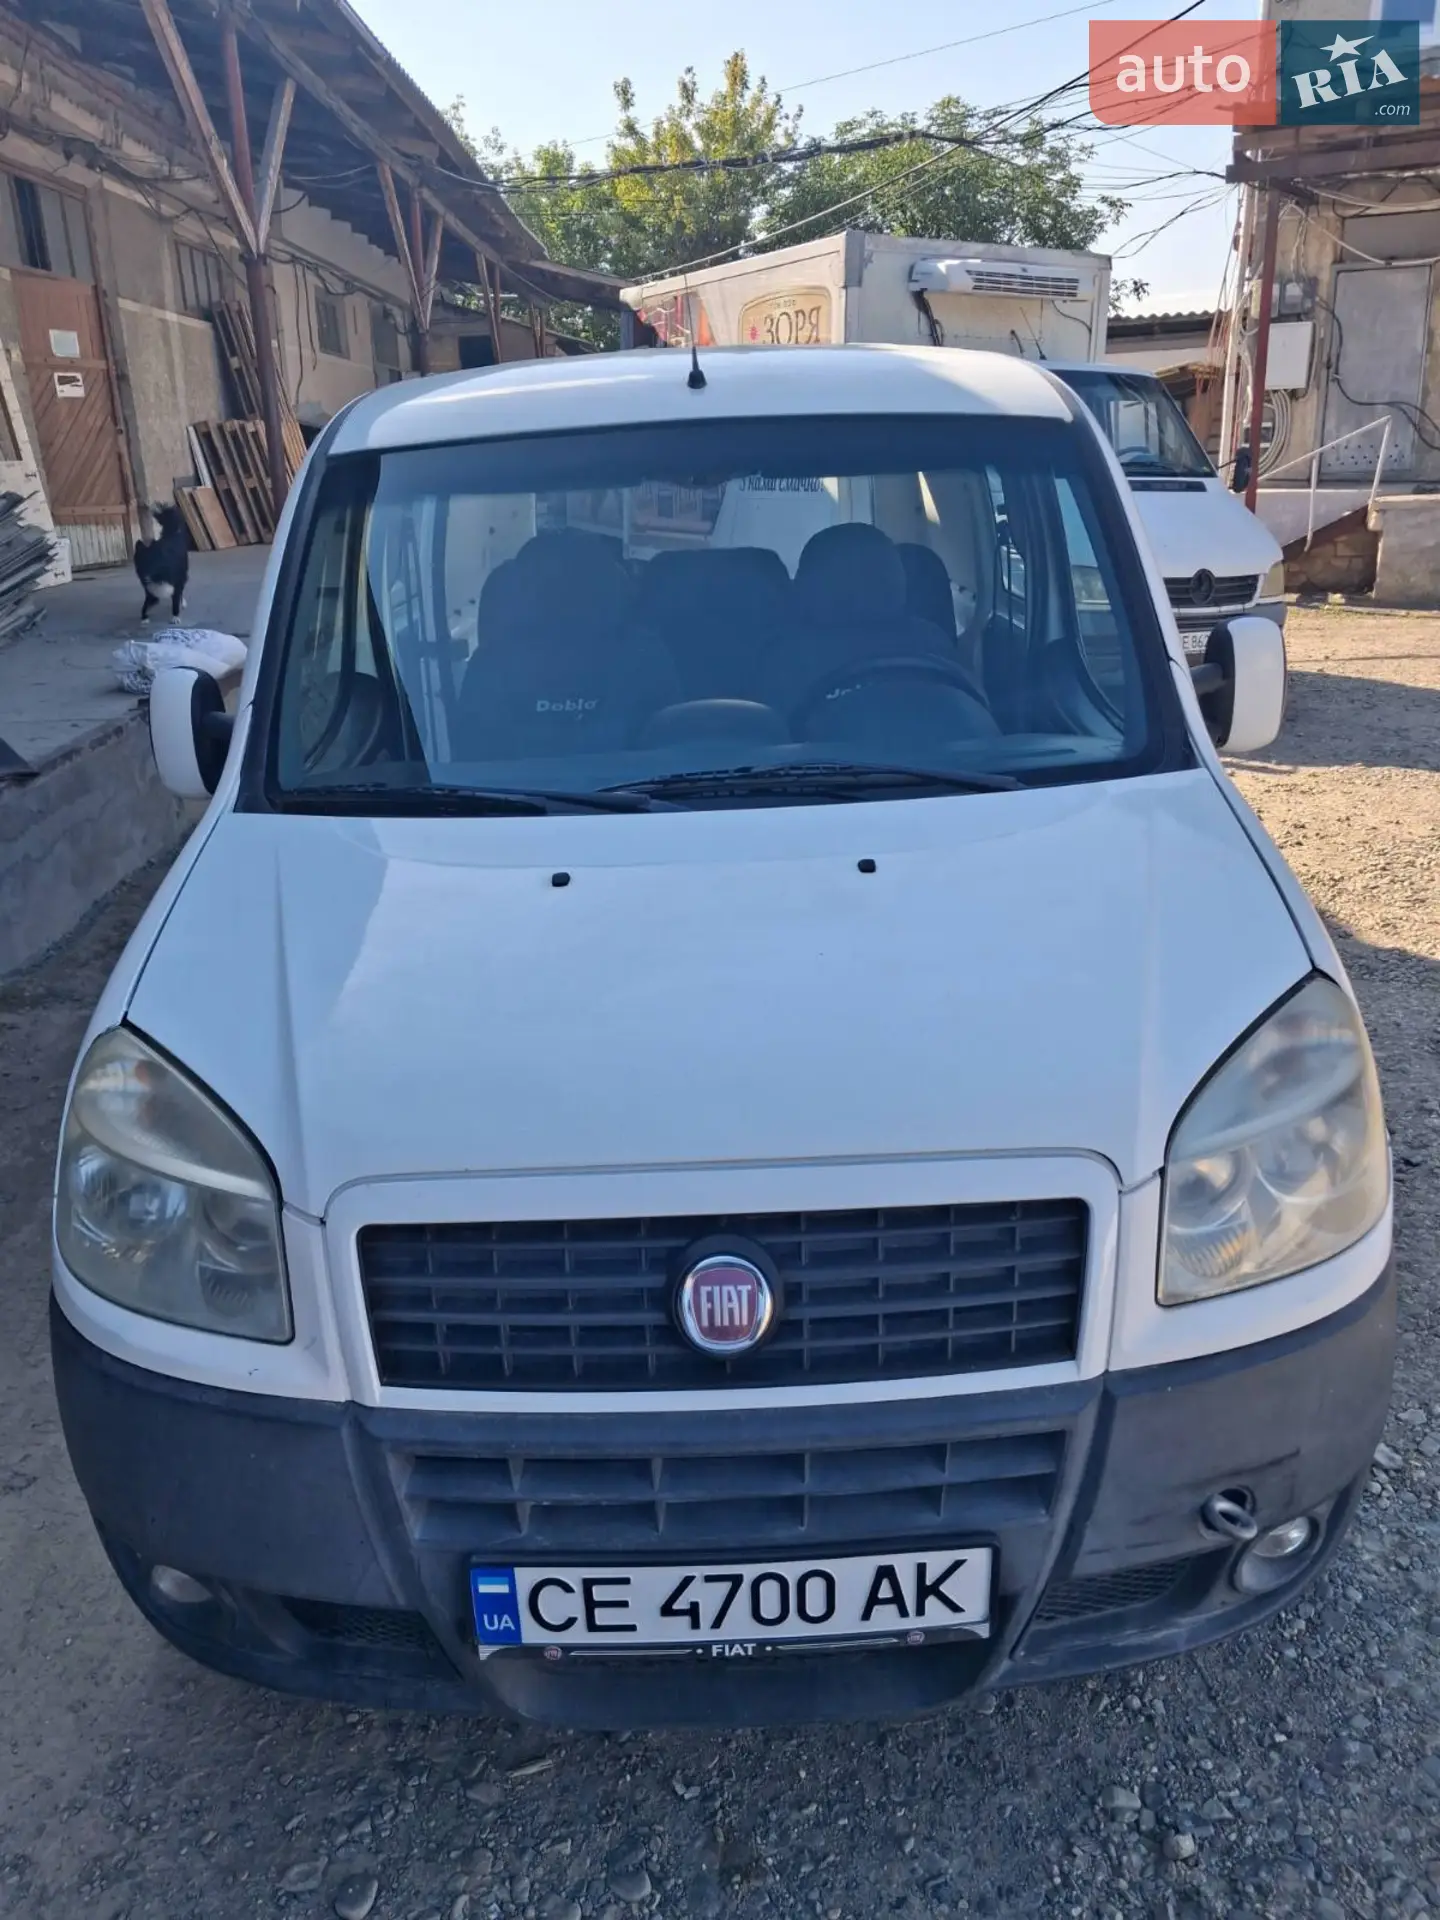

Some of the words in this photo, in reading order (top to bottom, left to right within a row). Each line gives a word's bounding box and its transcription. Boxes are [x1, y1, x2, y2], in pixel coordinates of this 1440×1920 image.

[763, 305, 822, 345] ЗОРЯ
[700, 1285, 752, 1327] FIAT
[528, 1576, 637, 1633] CE
[659, 1568, 837, 1630] 4700
[860, 1558, 969, 1621] AK
[483, 1614, 516, 1630] UA
[711, 1643, 757, 1657] FIAT
